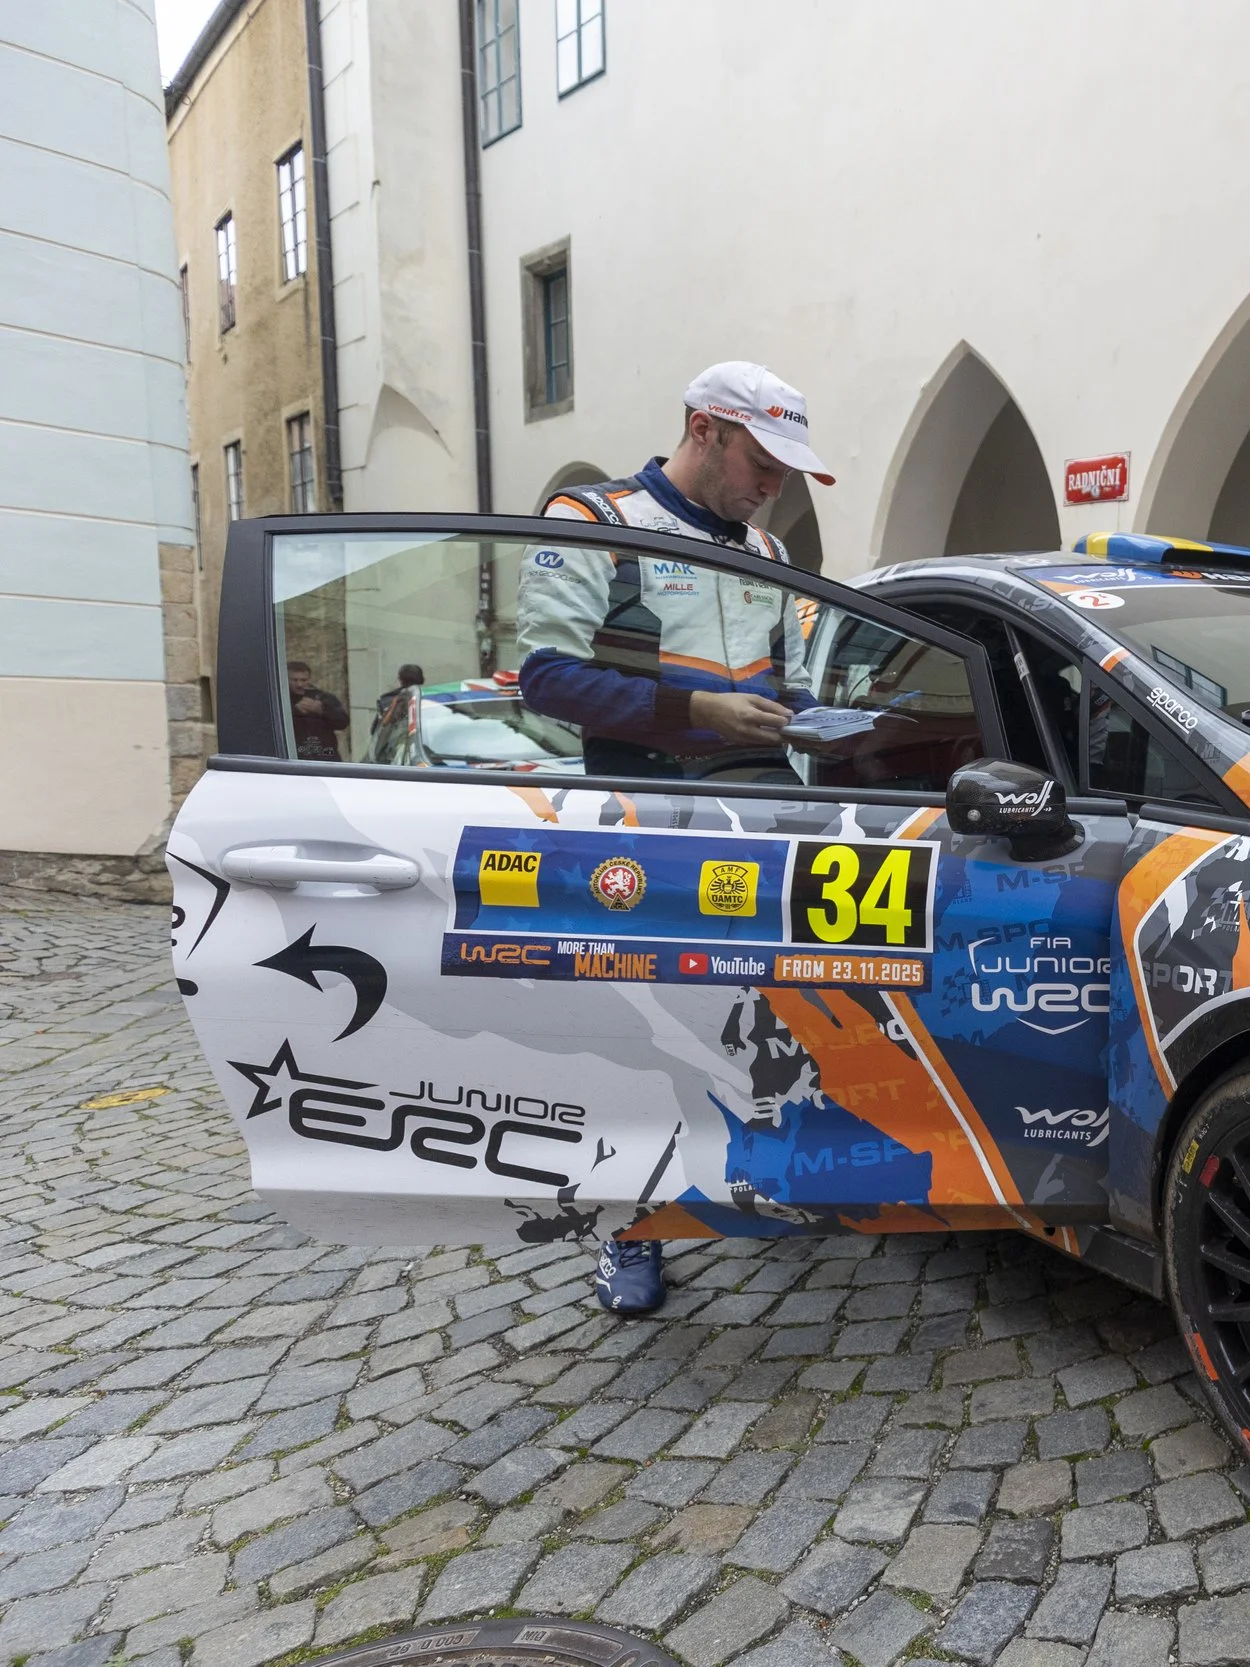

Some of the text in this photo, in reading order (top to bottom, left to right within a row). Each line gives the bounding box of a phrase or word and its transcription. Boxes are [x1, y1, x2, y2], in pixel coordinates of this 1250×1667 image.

[1068, 463, 1122, 491] RADNIČNÍ
[653, 563, 695, 575] MAK
[663, 583, 694, 591] MILLE
[1148, 687, 1198, 733] sparco
[482, 853, 537, 873] ADAC
[807, 845, 912, 944] 34
[461, 943, 551, 965] WRC
[557, 941, 615, 955] MORE THAN
[1030, 937, 1071, 949] FIA
[574, 952, 658, 980] MACHINE
[711, 957, 765, 975] YouTube
[783, 959, 921, 982] FROM 23.11.2025
[389, 1080, 586, 1127] JUNIOR
[289, 1088, 583, 1188] ERC
[1024, 1129, 1092, 1140] LUBRICANTS
